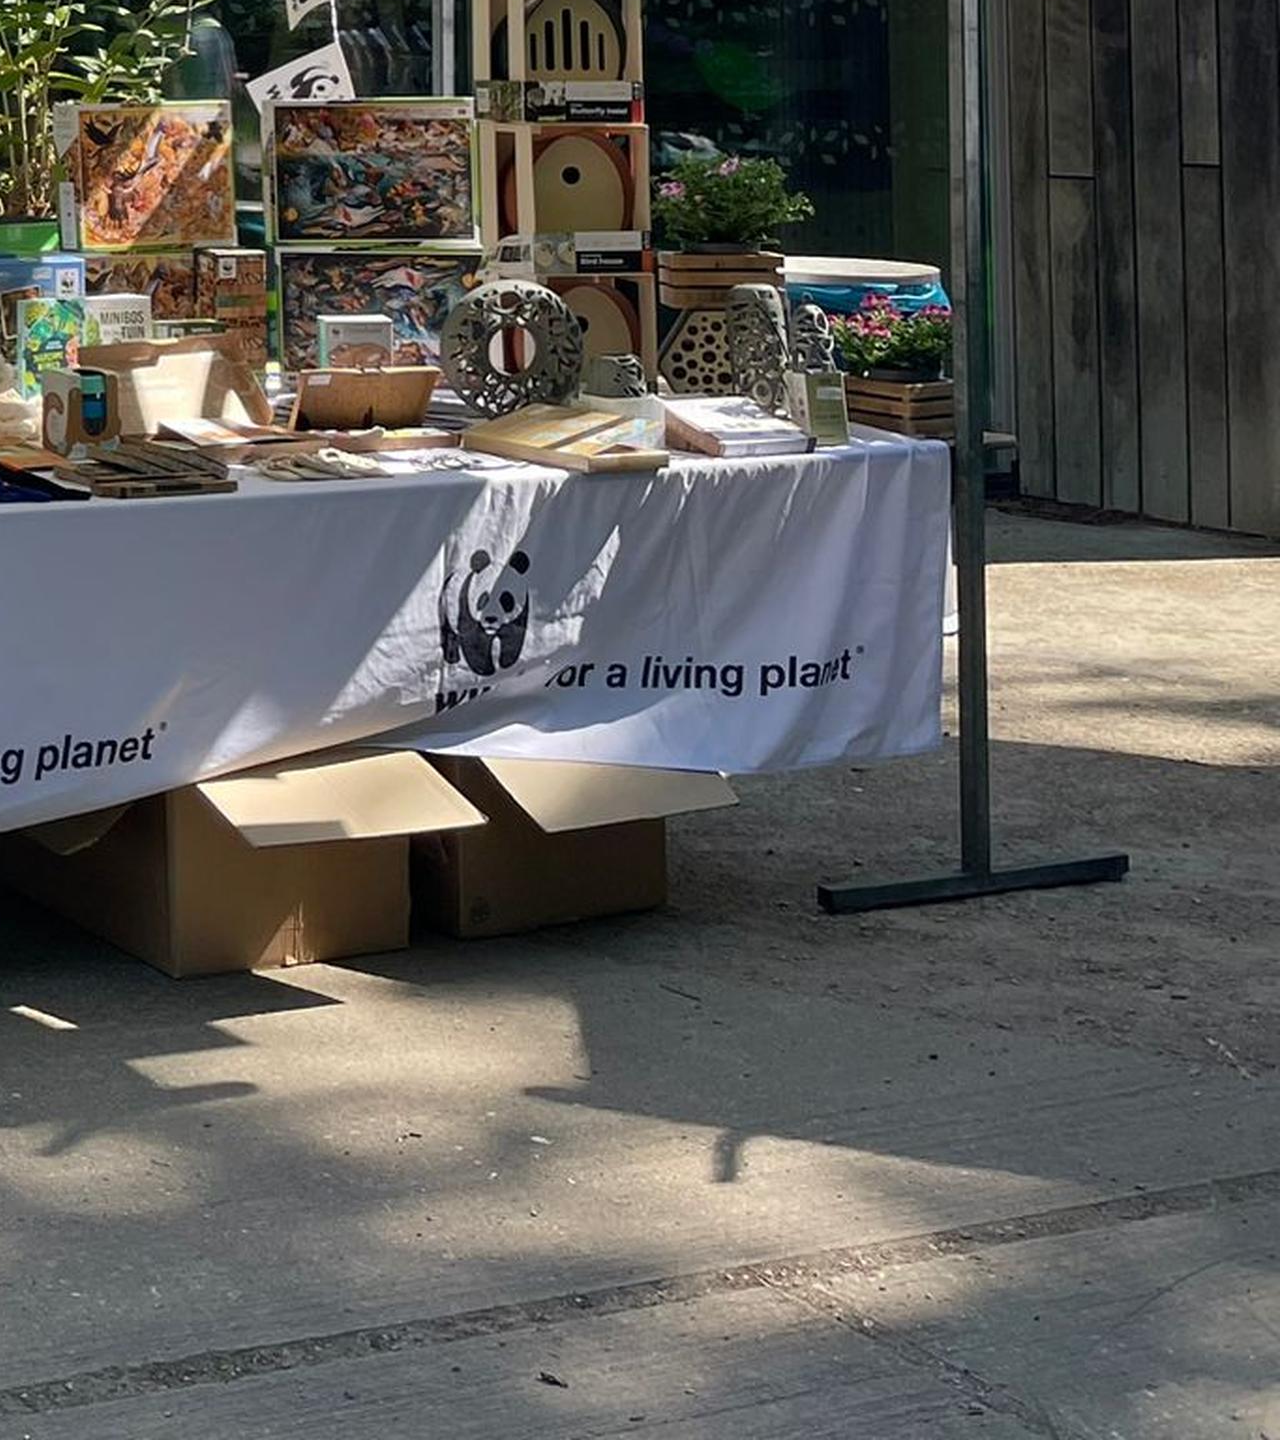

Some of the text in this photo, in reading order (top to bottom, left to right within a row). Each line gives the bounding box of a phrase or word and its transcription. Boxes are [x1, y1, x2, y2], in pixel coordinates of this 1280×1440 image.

[606, 662, 627, 688] a
[641, 654, 744, 696] living
[35, 727, 155, 781] planet
